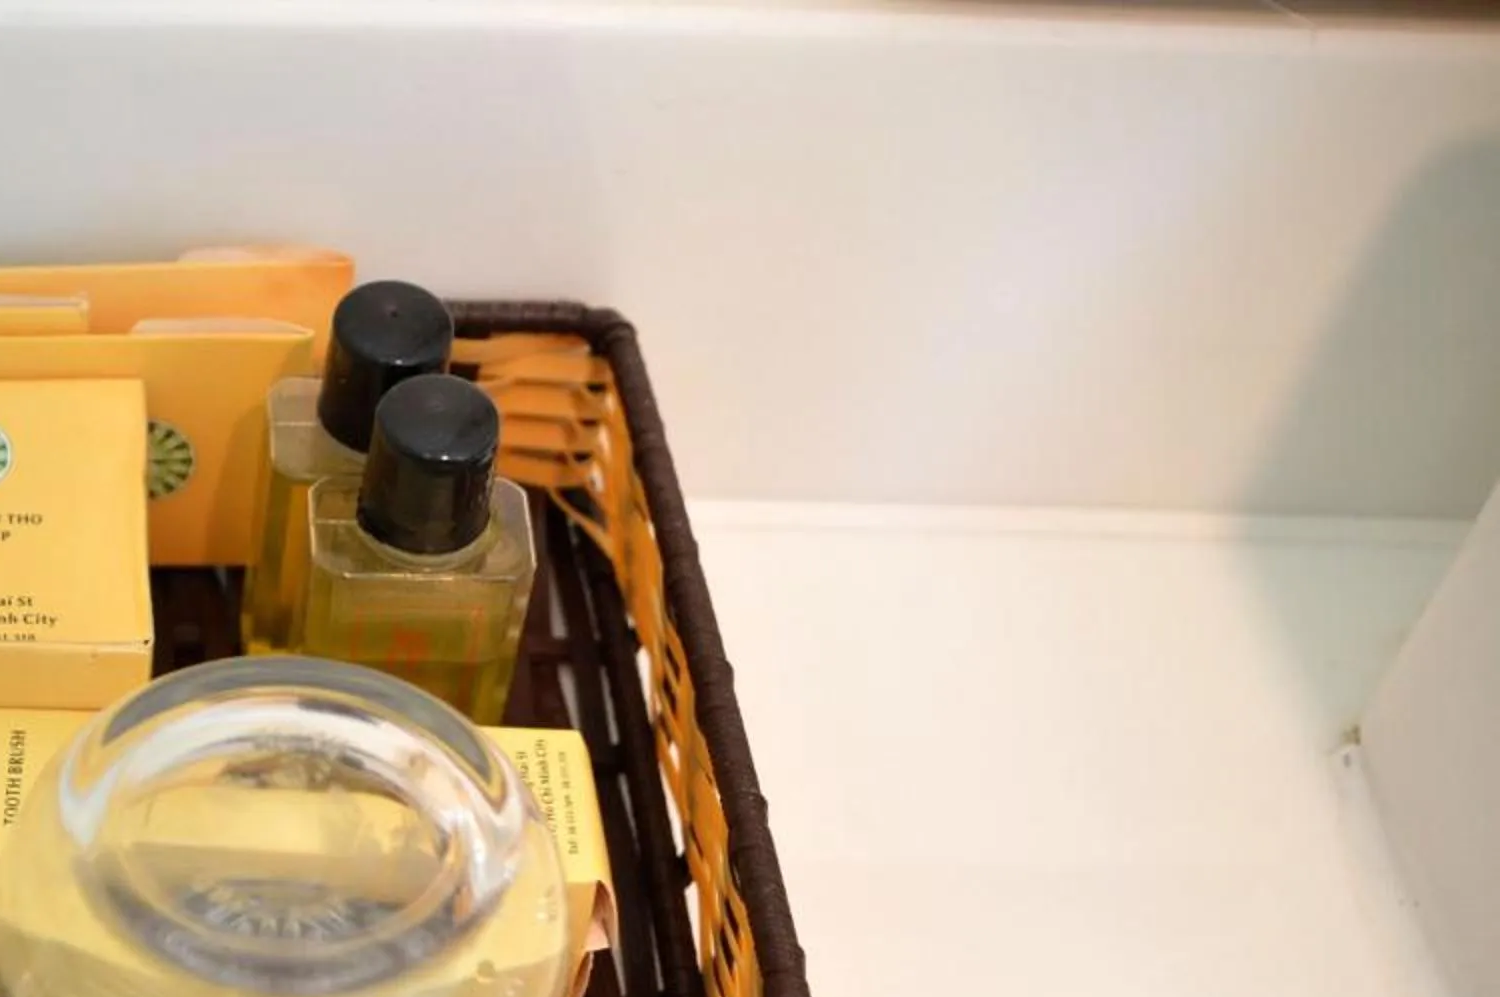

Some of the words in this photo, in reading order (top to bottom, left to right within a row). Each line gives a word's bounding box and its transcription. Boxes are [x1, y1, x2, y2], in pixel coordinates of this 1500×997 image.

[8, 513, 43, 526] THO
[17, 595, 34, 607] St
[23, 612, 58, 627] City
[7, 729, 27, 775] BRUSH
[3, 777, 21, 828] TOOTH
